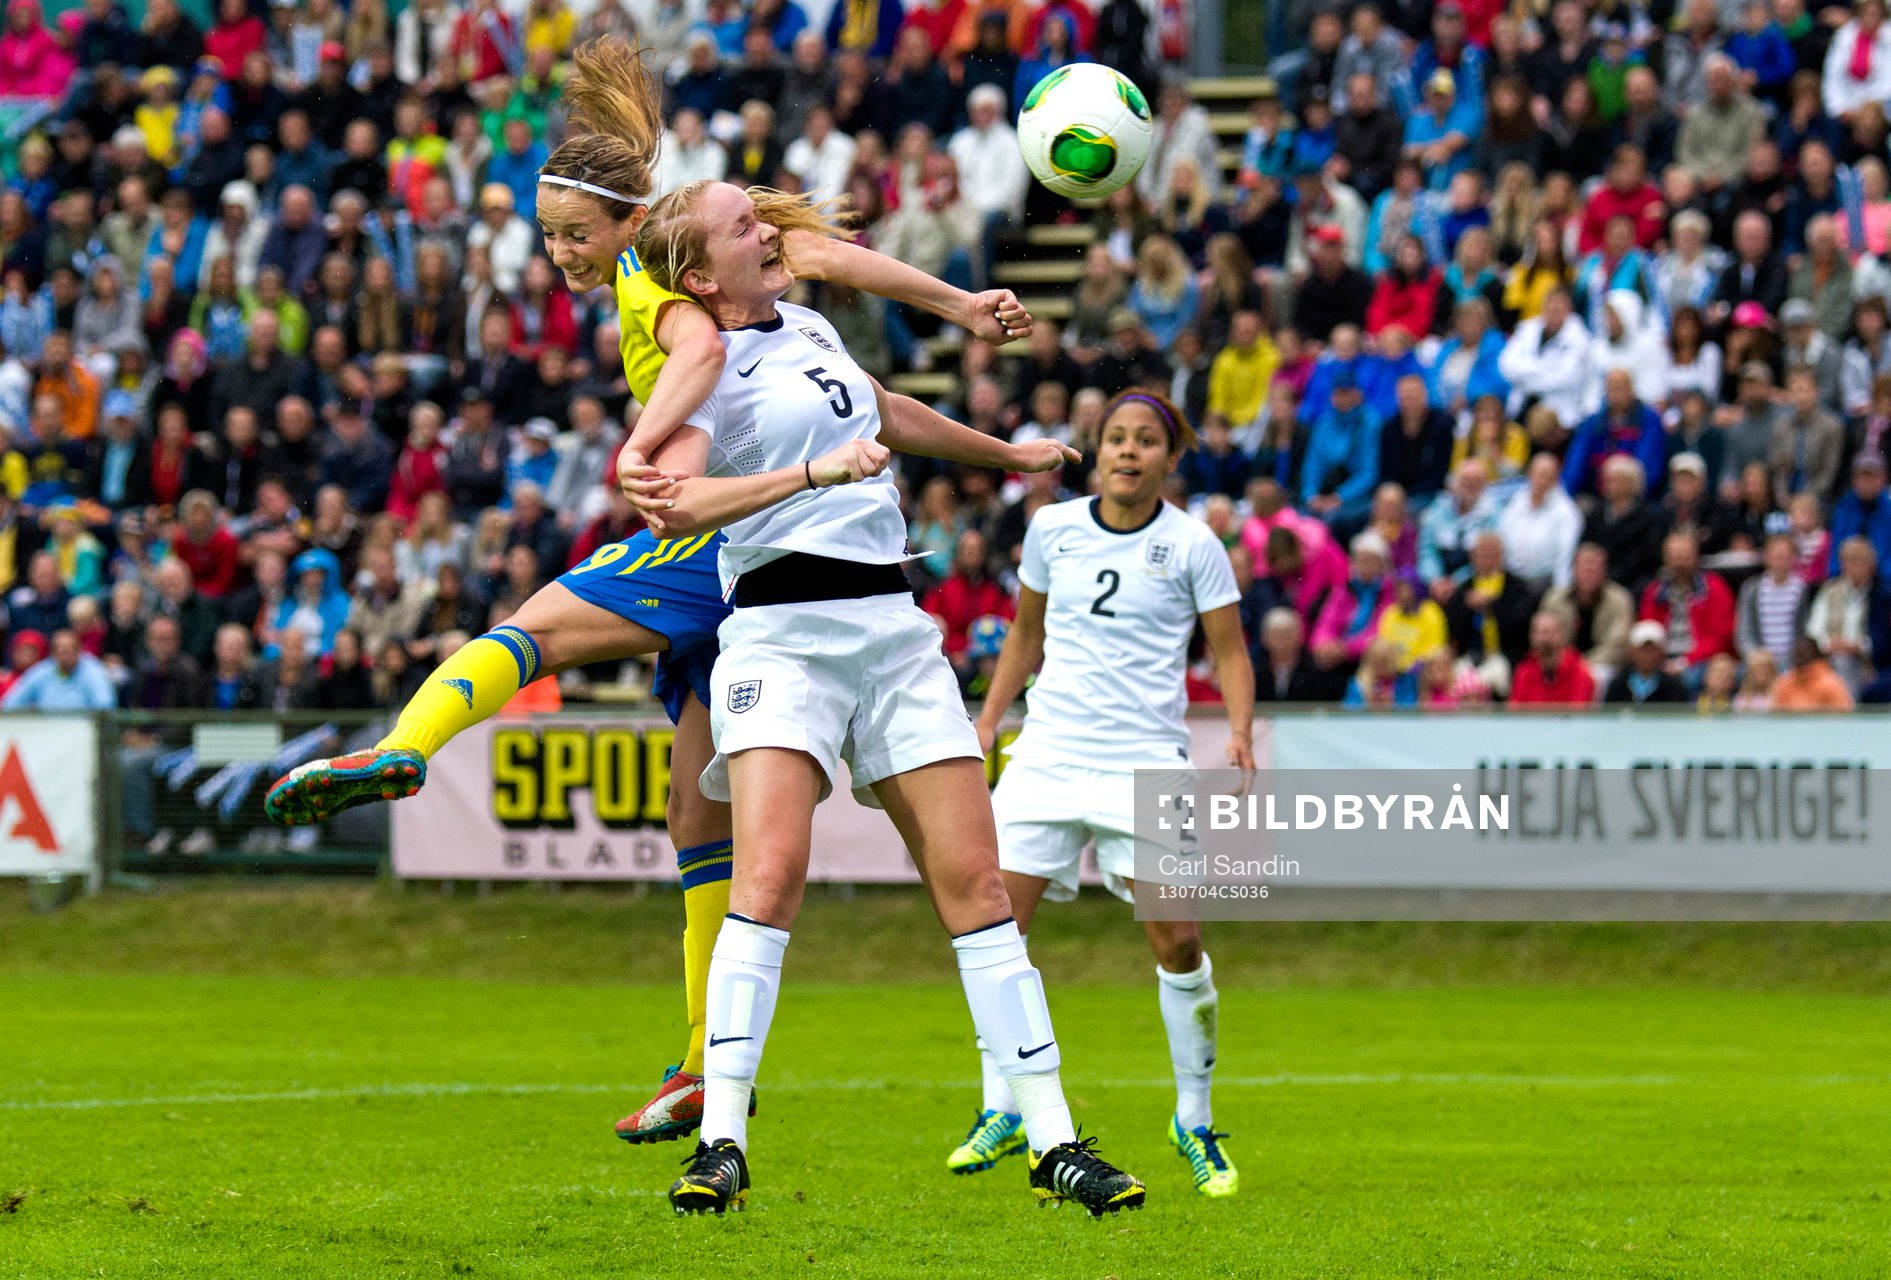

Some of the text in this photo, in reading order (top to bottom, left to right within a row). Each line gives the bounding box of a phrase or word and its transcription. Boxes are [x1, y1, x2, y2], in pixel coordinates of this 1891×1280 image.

[803, 366, 853, 419] 5
[1089, 569, 1120, 618] 2
[1477, 758, 1869, 842] HEJA SVERIGE!
[503, 839, 662, 869] BLAD
